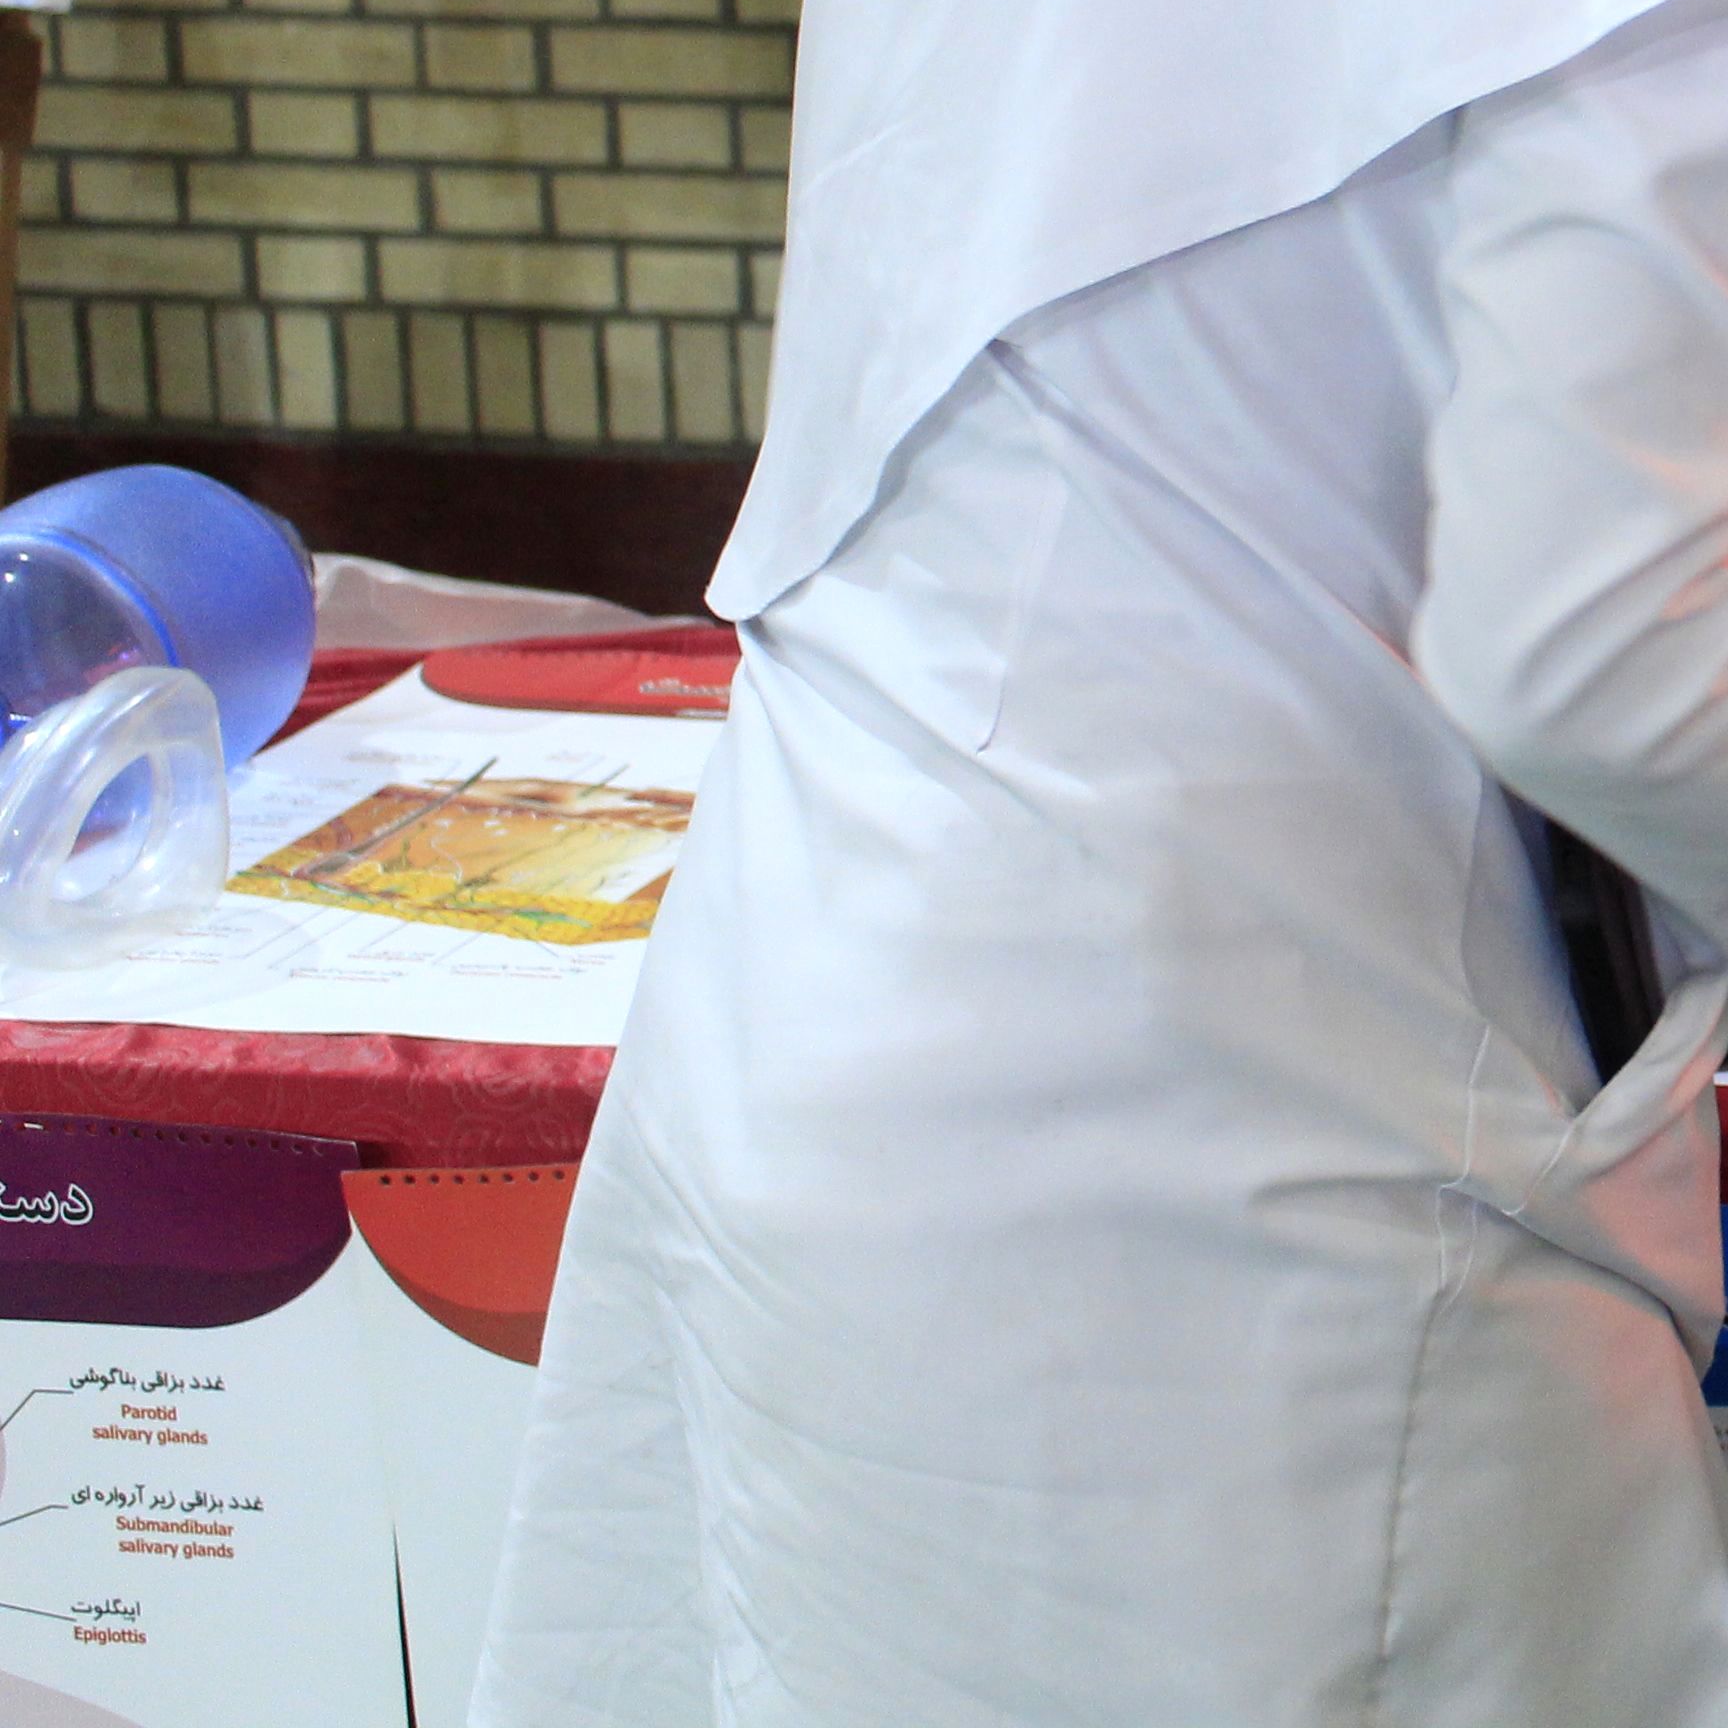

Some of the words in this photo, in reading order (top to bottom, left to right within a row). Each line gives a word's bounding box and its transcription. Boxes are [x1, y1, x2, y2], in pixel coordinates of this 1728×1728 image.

[69, 1367, 137, 1393] بناگوشی
[140, 1371, 185, 1393] بزاقی
[189, 1375, 226, 1392] غدد
[120, 1404, 178, 1421] Parotid
[92, 1424, 153, 1445] salivary
[157, 1428, 209, 1445] glands
[149, 1490, 176, 1511] زیر
[180, 1489, 224, 1513] بزاقی
[228, 1495, 264, 1512] غدد
[116, 1515, 235, 1537] Submandibular
[118, 1538, 179, 1559] salivary
[182, 1541, 235, 1559] glands
[70, 1598, 142, 1622] اپیگلوت
[73, 1625, 148, 1646] Epiglottis
